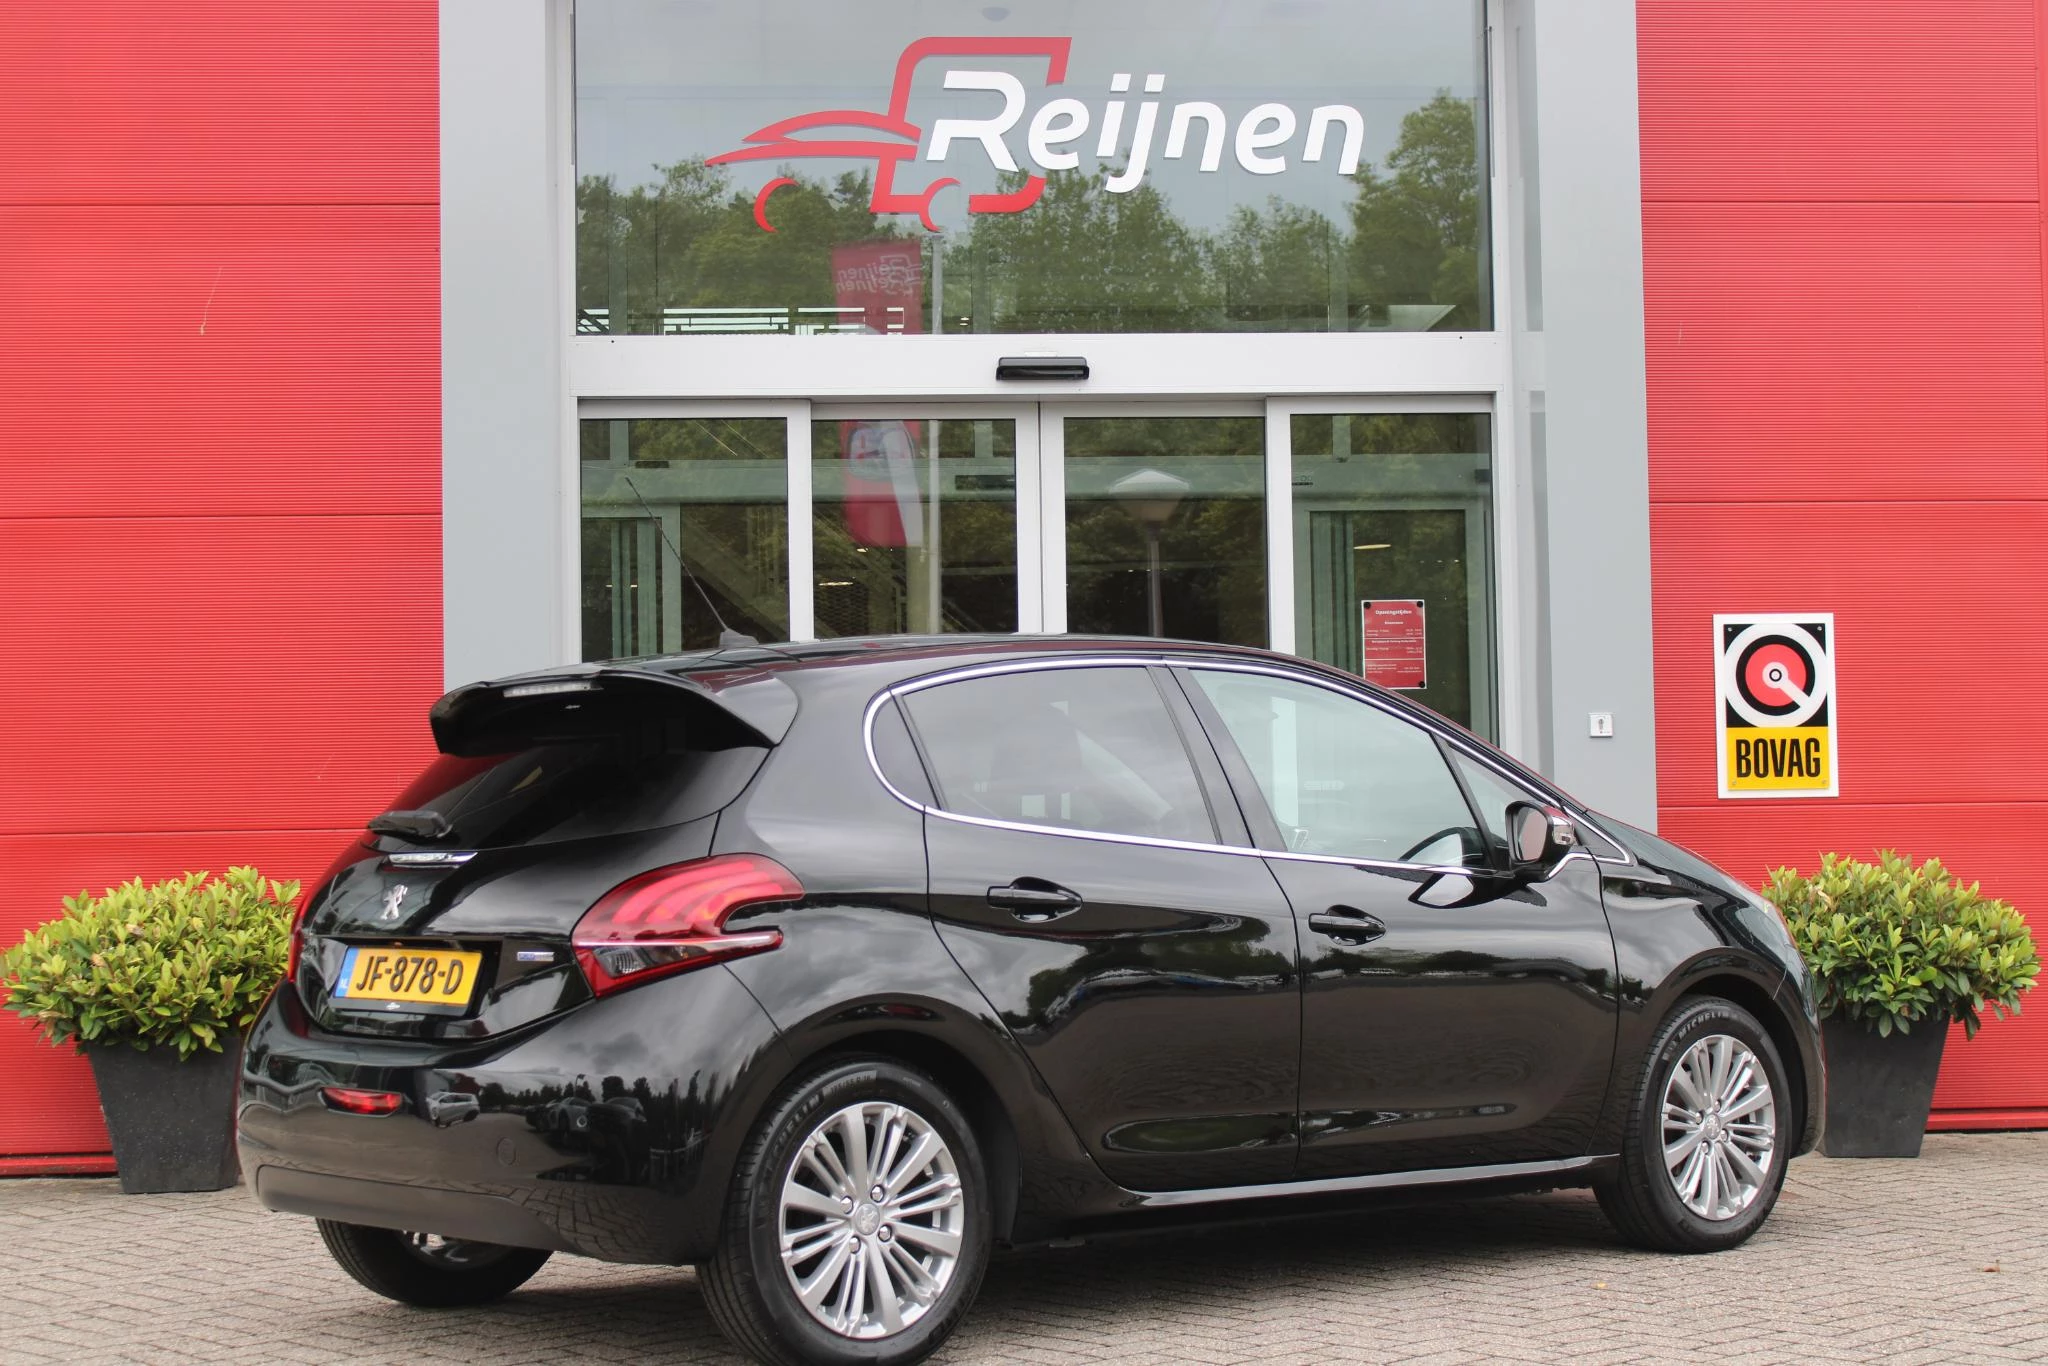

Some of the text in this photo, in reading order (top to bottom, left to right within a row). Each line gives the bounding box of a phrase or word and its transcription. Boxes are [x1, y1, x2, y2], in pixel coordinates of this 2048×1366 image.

[925, 70, 1364, 193] Reijnen
[1735, 738, 1821, 778] BOVAG
[356, 955, 464, 995] JF-878-D
